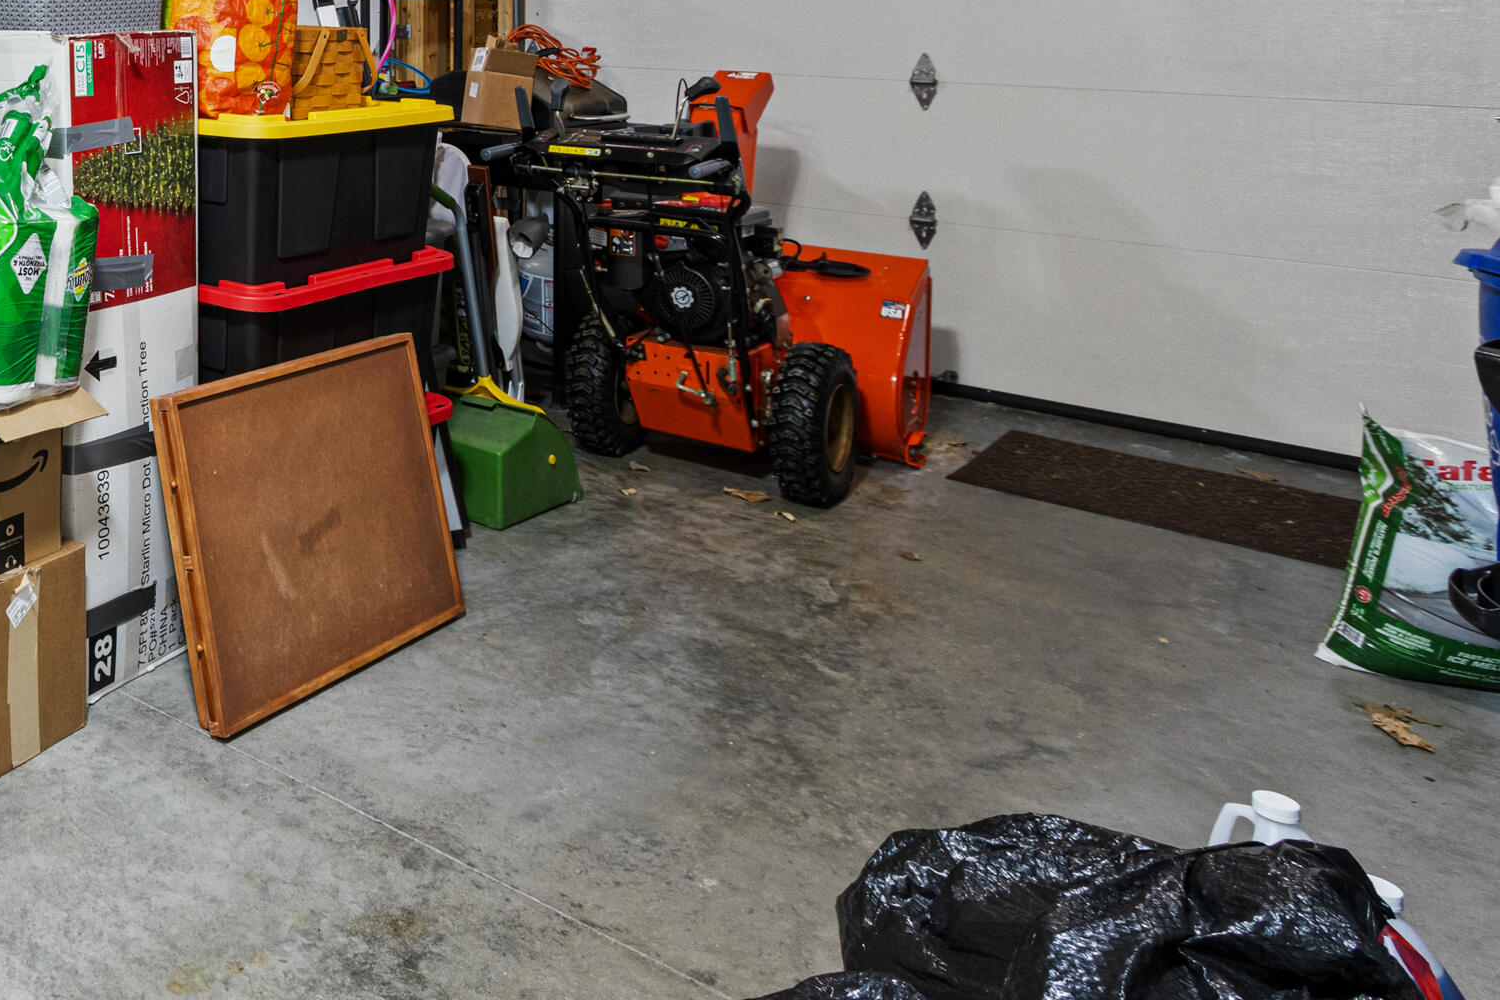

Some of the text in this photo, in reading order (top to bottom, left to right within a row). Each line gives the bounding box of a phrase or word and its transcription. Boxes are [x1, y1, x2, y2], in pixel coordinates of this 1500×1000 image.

[17, 267, 41, 277] MOST
[880, 306, 903, 320] USA
[137, 340, 150, 425] nction Tree
[97, 470, 110, 561] 10043639
[141, 462, 151, 586] Starlin Micro Dot
[158, 604, 169, 657] CHINA
[168, 600, 179, 635] Pack
[93, 632, 113, 684] 28
[138, 629, 148, 669] 7.5Ft
[1446, 655, 1500, 672] ICE MEL
